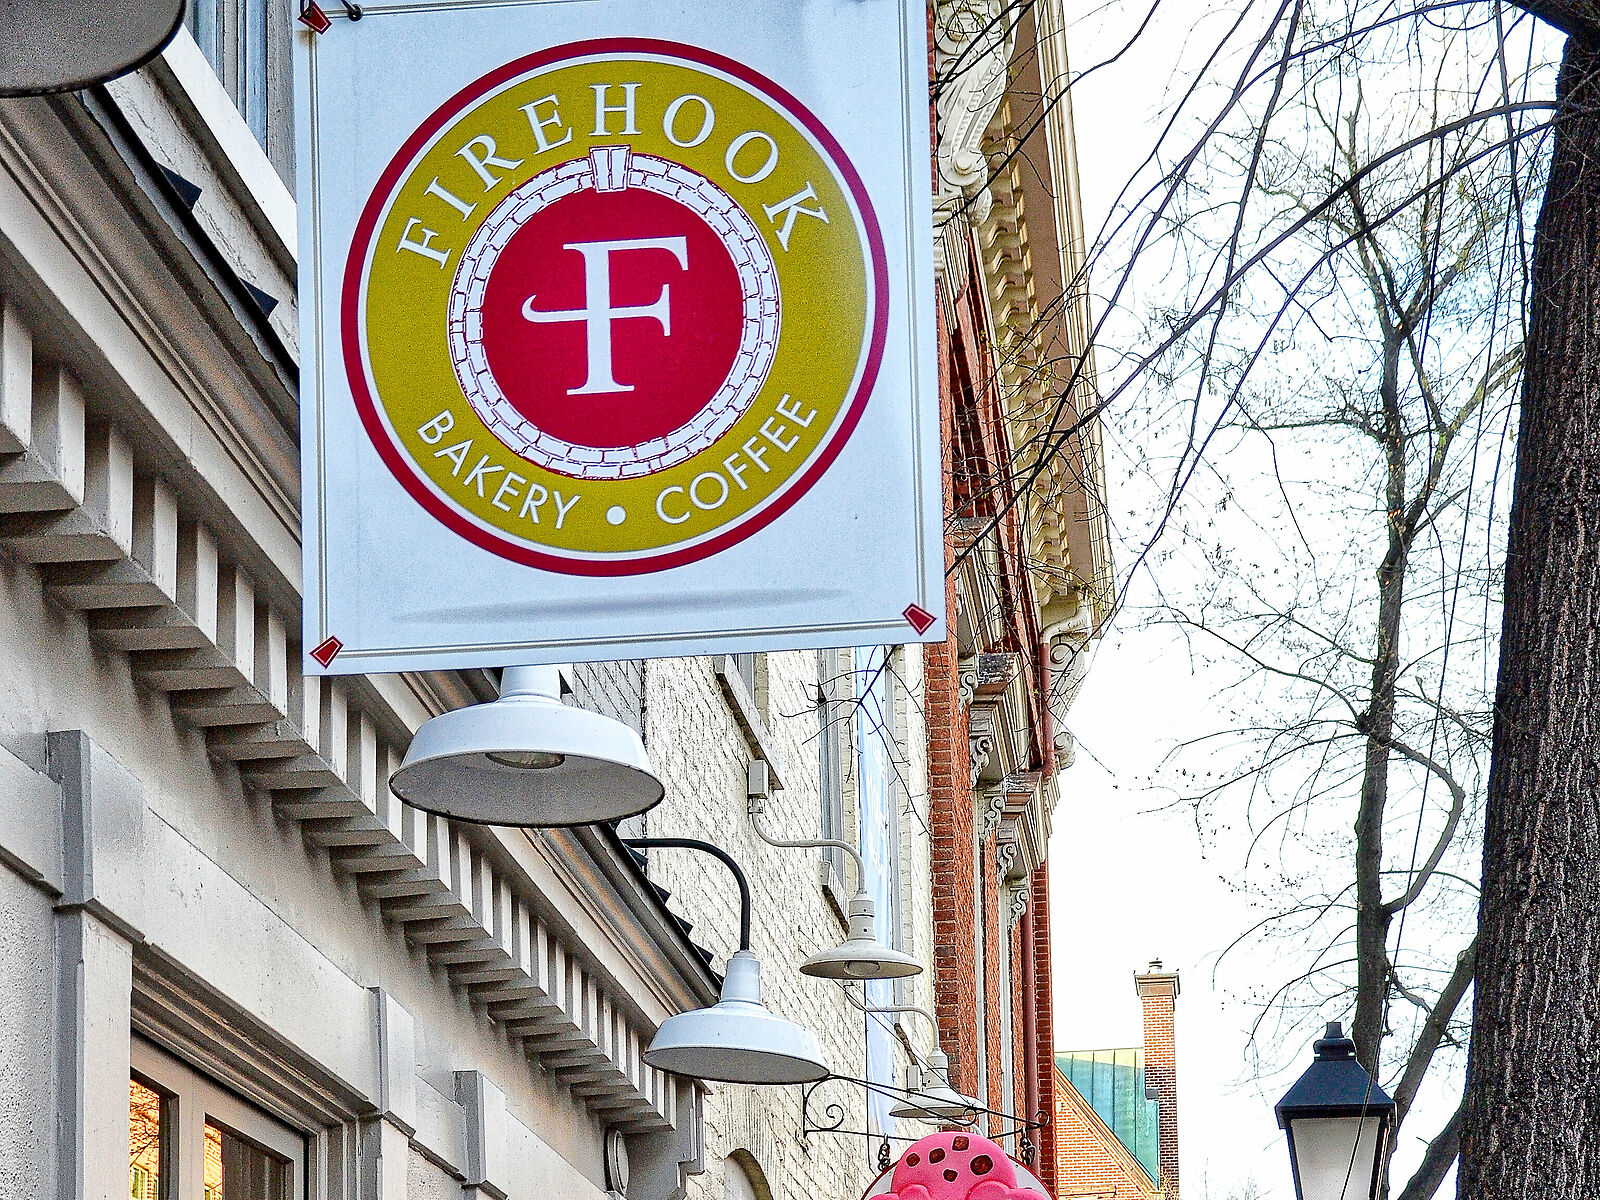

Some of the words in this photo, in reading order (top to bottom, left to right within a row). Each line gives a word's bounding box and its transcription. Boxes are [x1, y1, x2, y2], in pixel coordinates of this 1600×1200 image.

[396, 82, 830, 269] FIREHOOK
[521, 236, 689, 396] F
[416, 409, 581, 531] BAKERY
[656, 393, 818, 525] COFFEE
